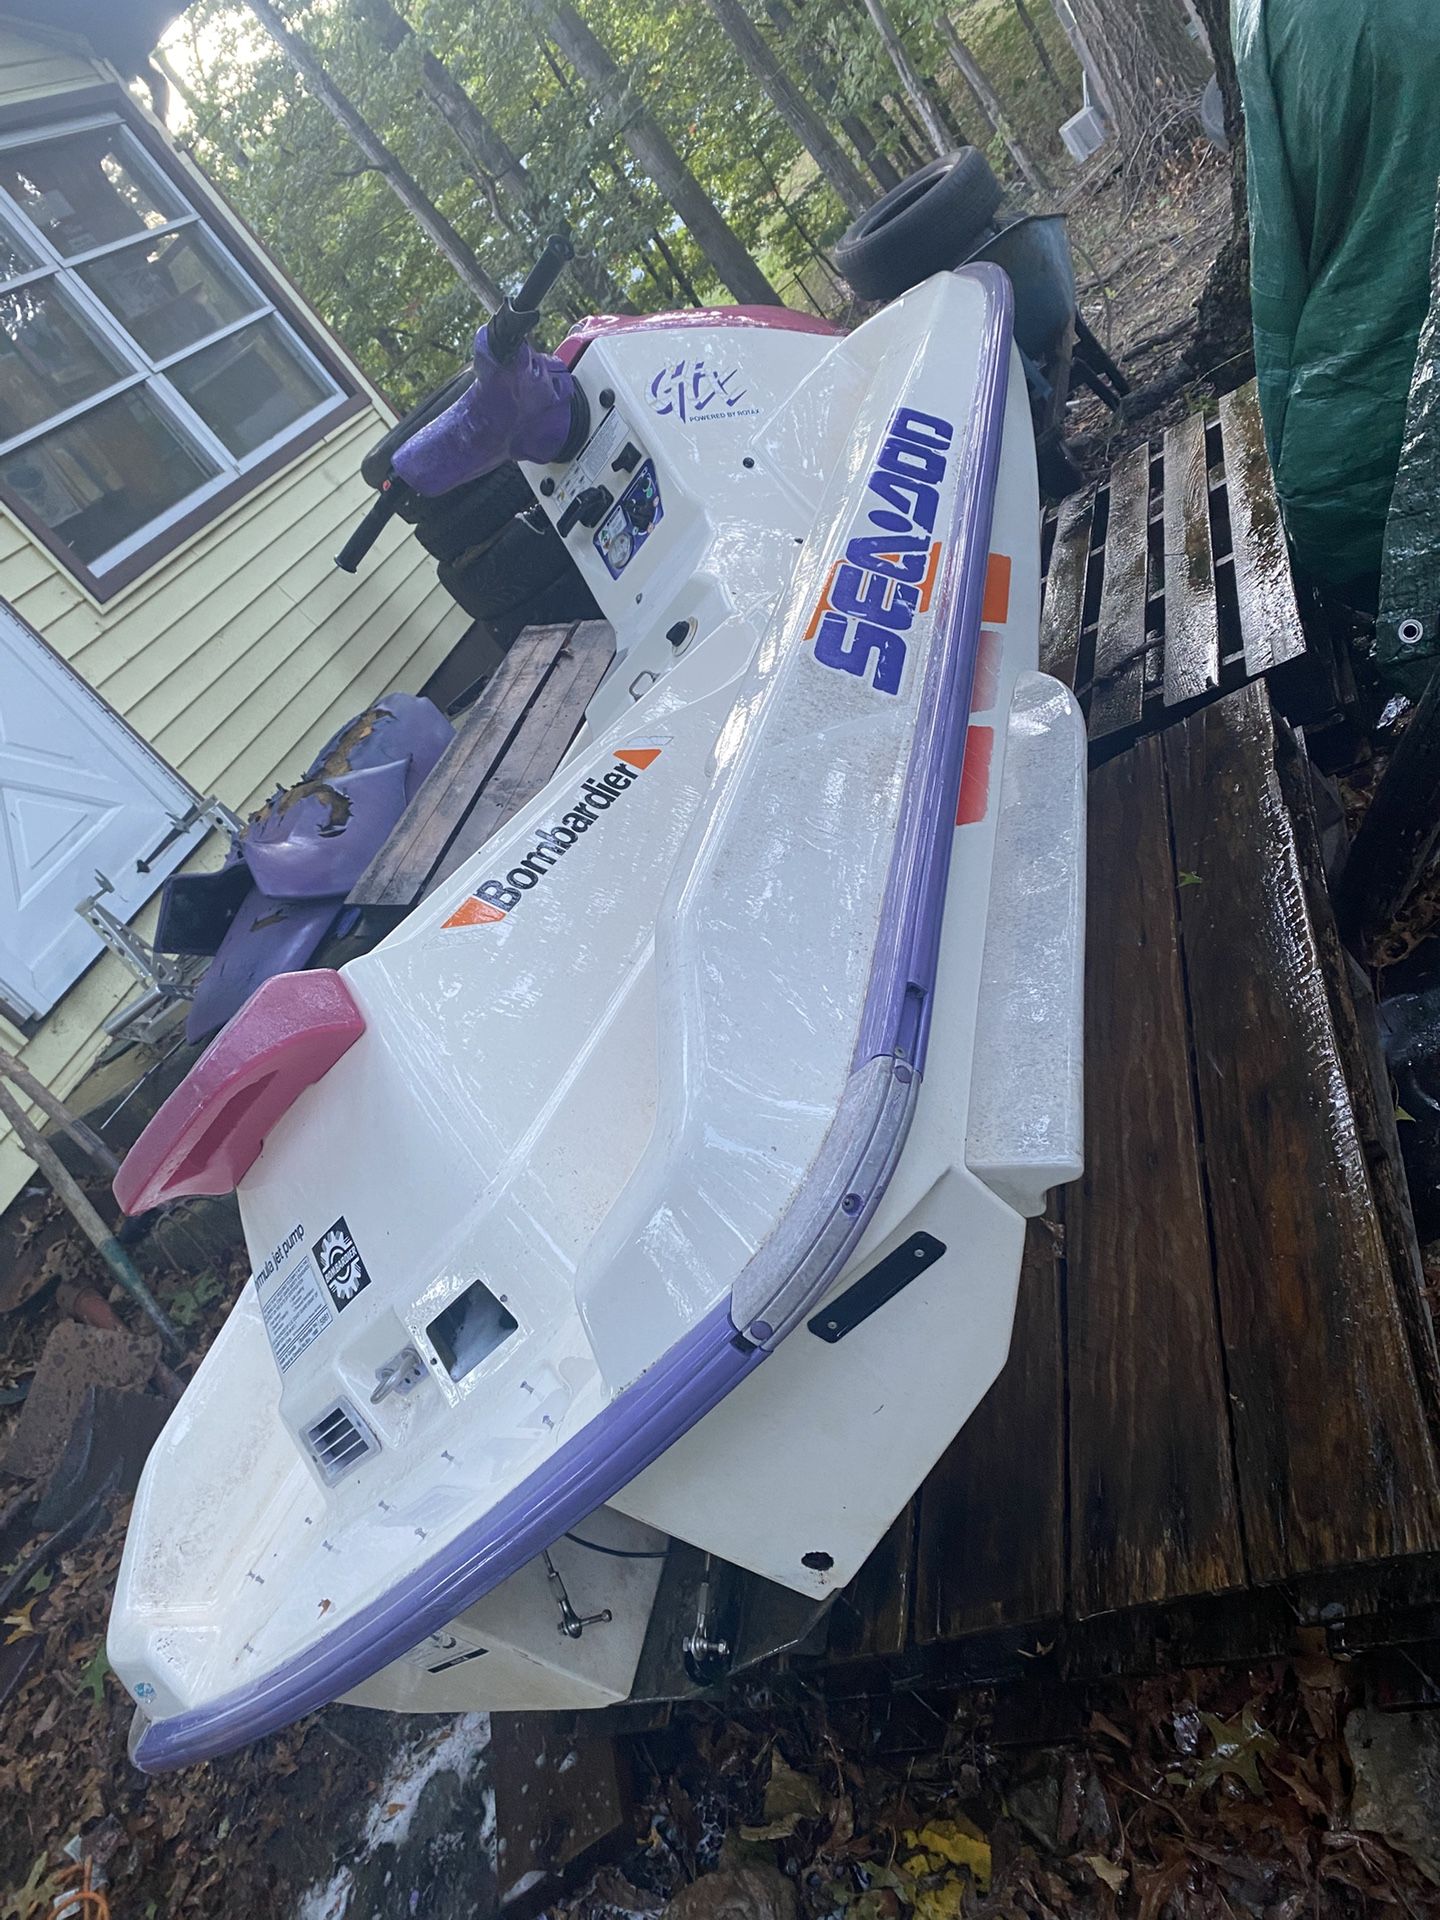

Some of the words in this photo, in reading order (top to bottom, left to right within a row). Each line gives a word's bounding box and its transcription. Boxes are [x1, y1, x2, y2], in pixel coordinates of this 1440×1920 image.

[689, 412, 726, 422] POWERED
[472, 762, 639, 913] Bombardier
[271, 1245, 284, 1271] jet
[282, 1224, 304, 1259] pump
[324, 1245, 358, 1284] BOMBARDIER
